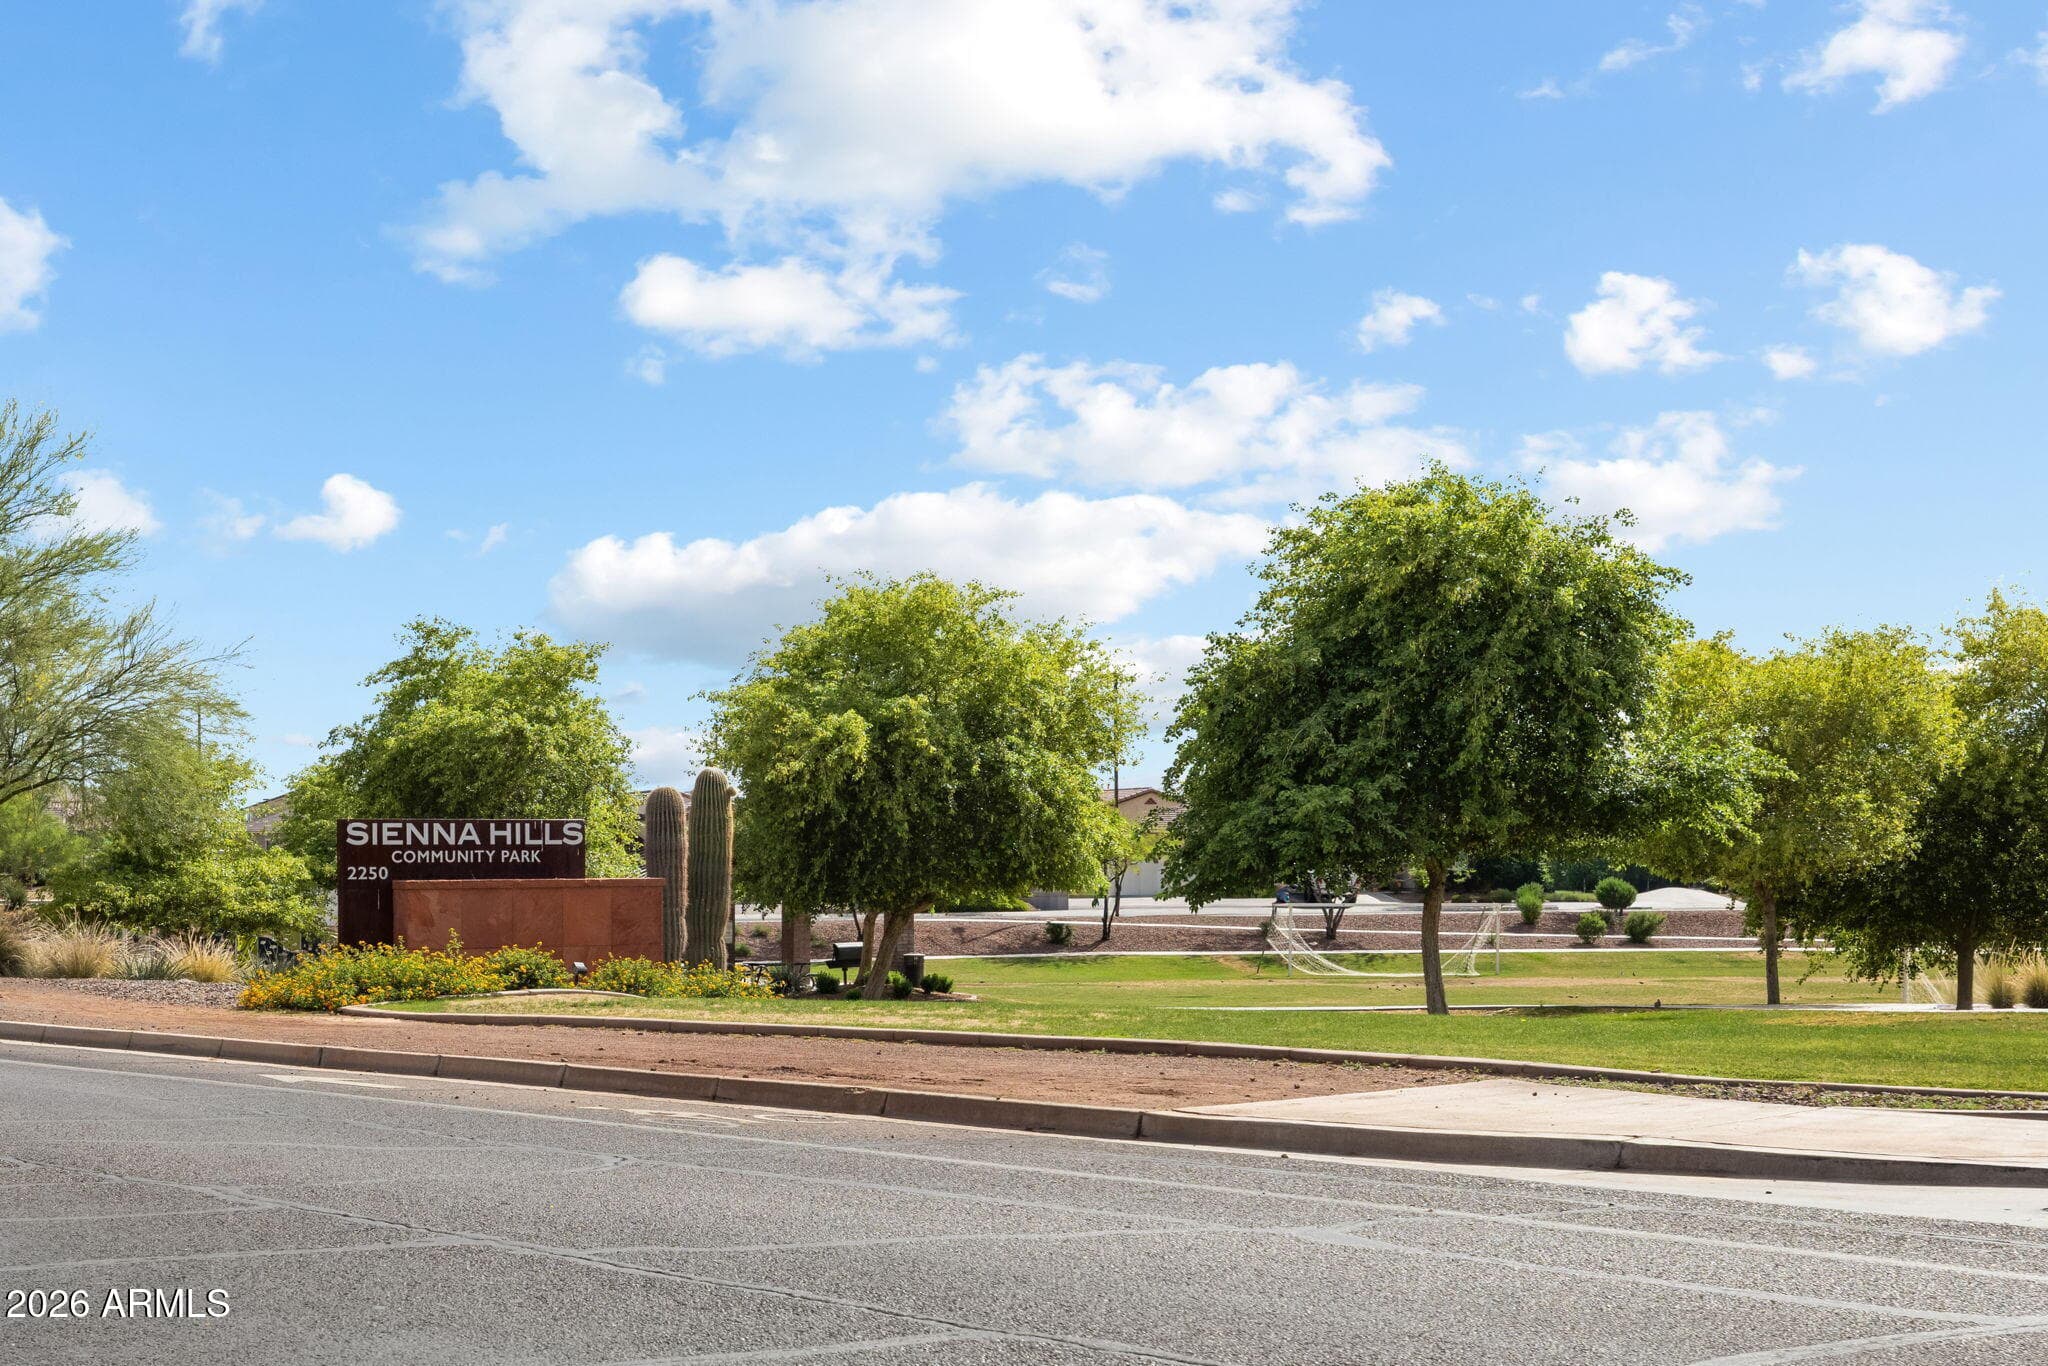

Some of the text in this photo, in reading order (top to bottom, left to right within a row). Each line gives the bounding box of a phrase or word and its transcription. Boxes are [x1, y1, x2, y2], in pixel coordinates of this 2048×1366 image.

[346, 822, 583, 846] SIENNA HILLS
[391, 850, 542, 864] COMMUNITY PARK
[347, 866, 389, 881] 2250
